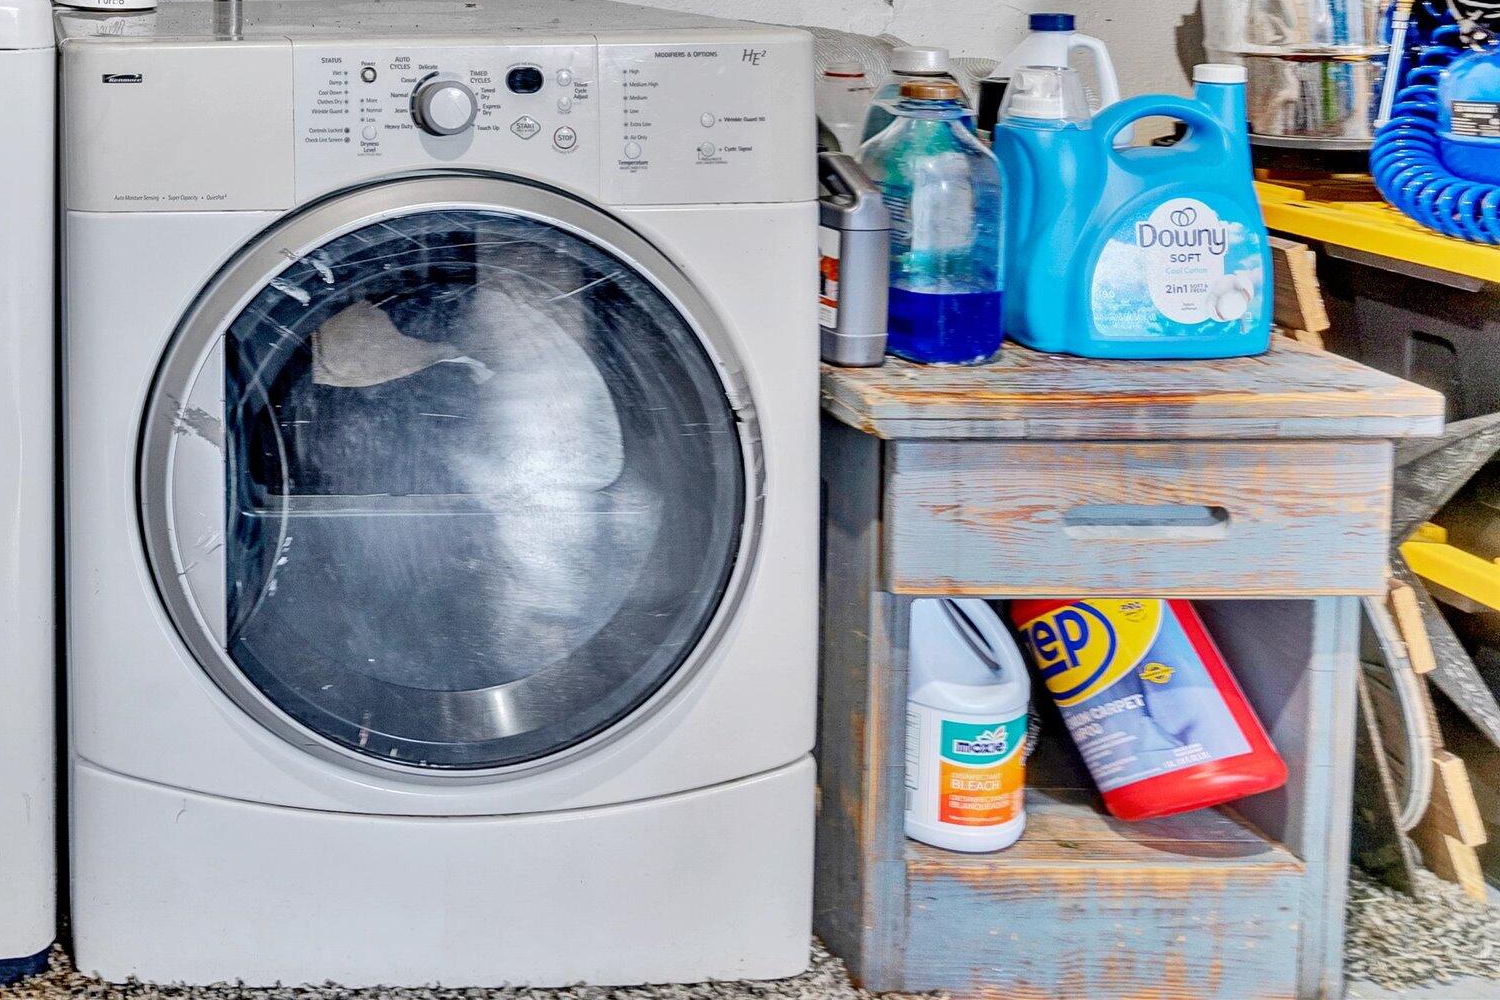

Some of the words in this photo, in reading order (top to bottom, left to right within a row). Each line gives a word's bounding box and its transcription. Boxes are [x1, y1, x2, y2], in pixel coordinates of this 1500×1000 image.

[167, 194, 180, 202] Super
[180, 194, 198, 202] Capacity
[1138, 223, 1226, 255] Downy
[1170, 253, 1202, 263] SOFT
[1165, 267, 1183, 275] Cool
[1184, 267, 1208, 275] Cotton
[1165, 284, 1188, 294] 2in1
[952, 780, 1000, 791] BLEACH
